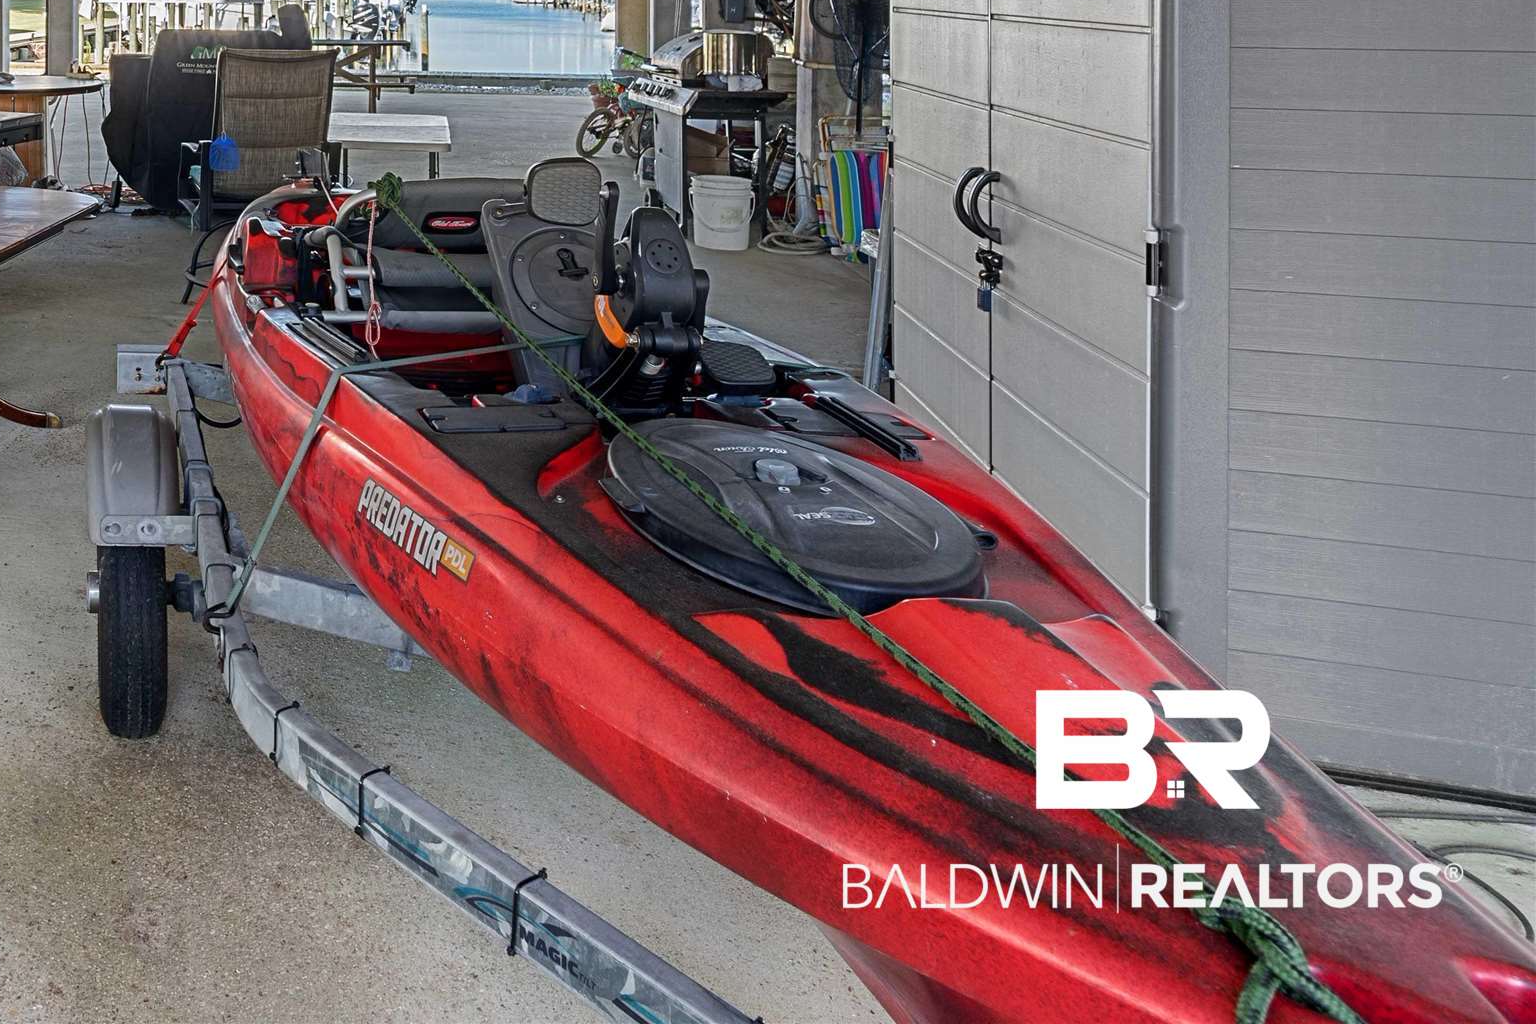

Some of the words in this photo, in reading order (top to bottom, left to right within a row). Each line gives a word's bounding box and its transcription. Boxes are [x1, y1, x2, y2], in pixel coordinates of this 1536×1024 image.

[190, 43, 224, 59] GM
[357, 478, 448, 576] PREDATOR
[444, 543, 467, 574] PDL
[519, 924, 579, 978] MAGIC
